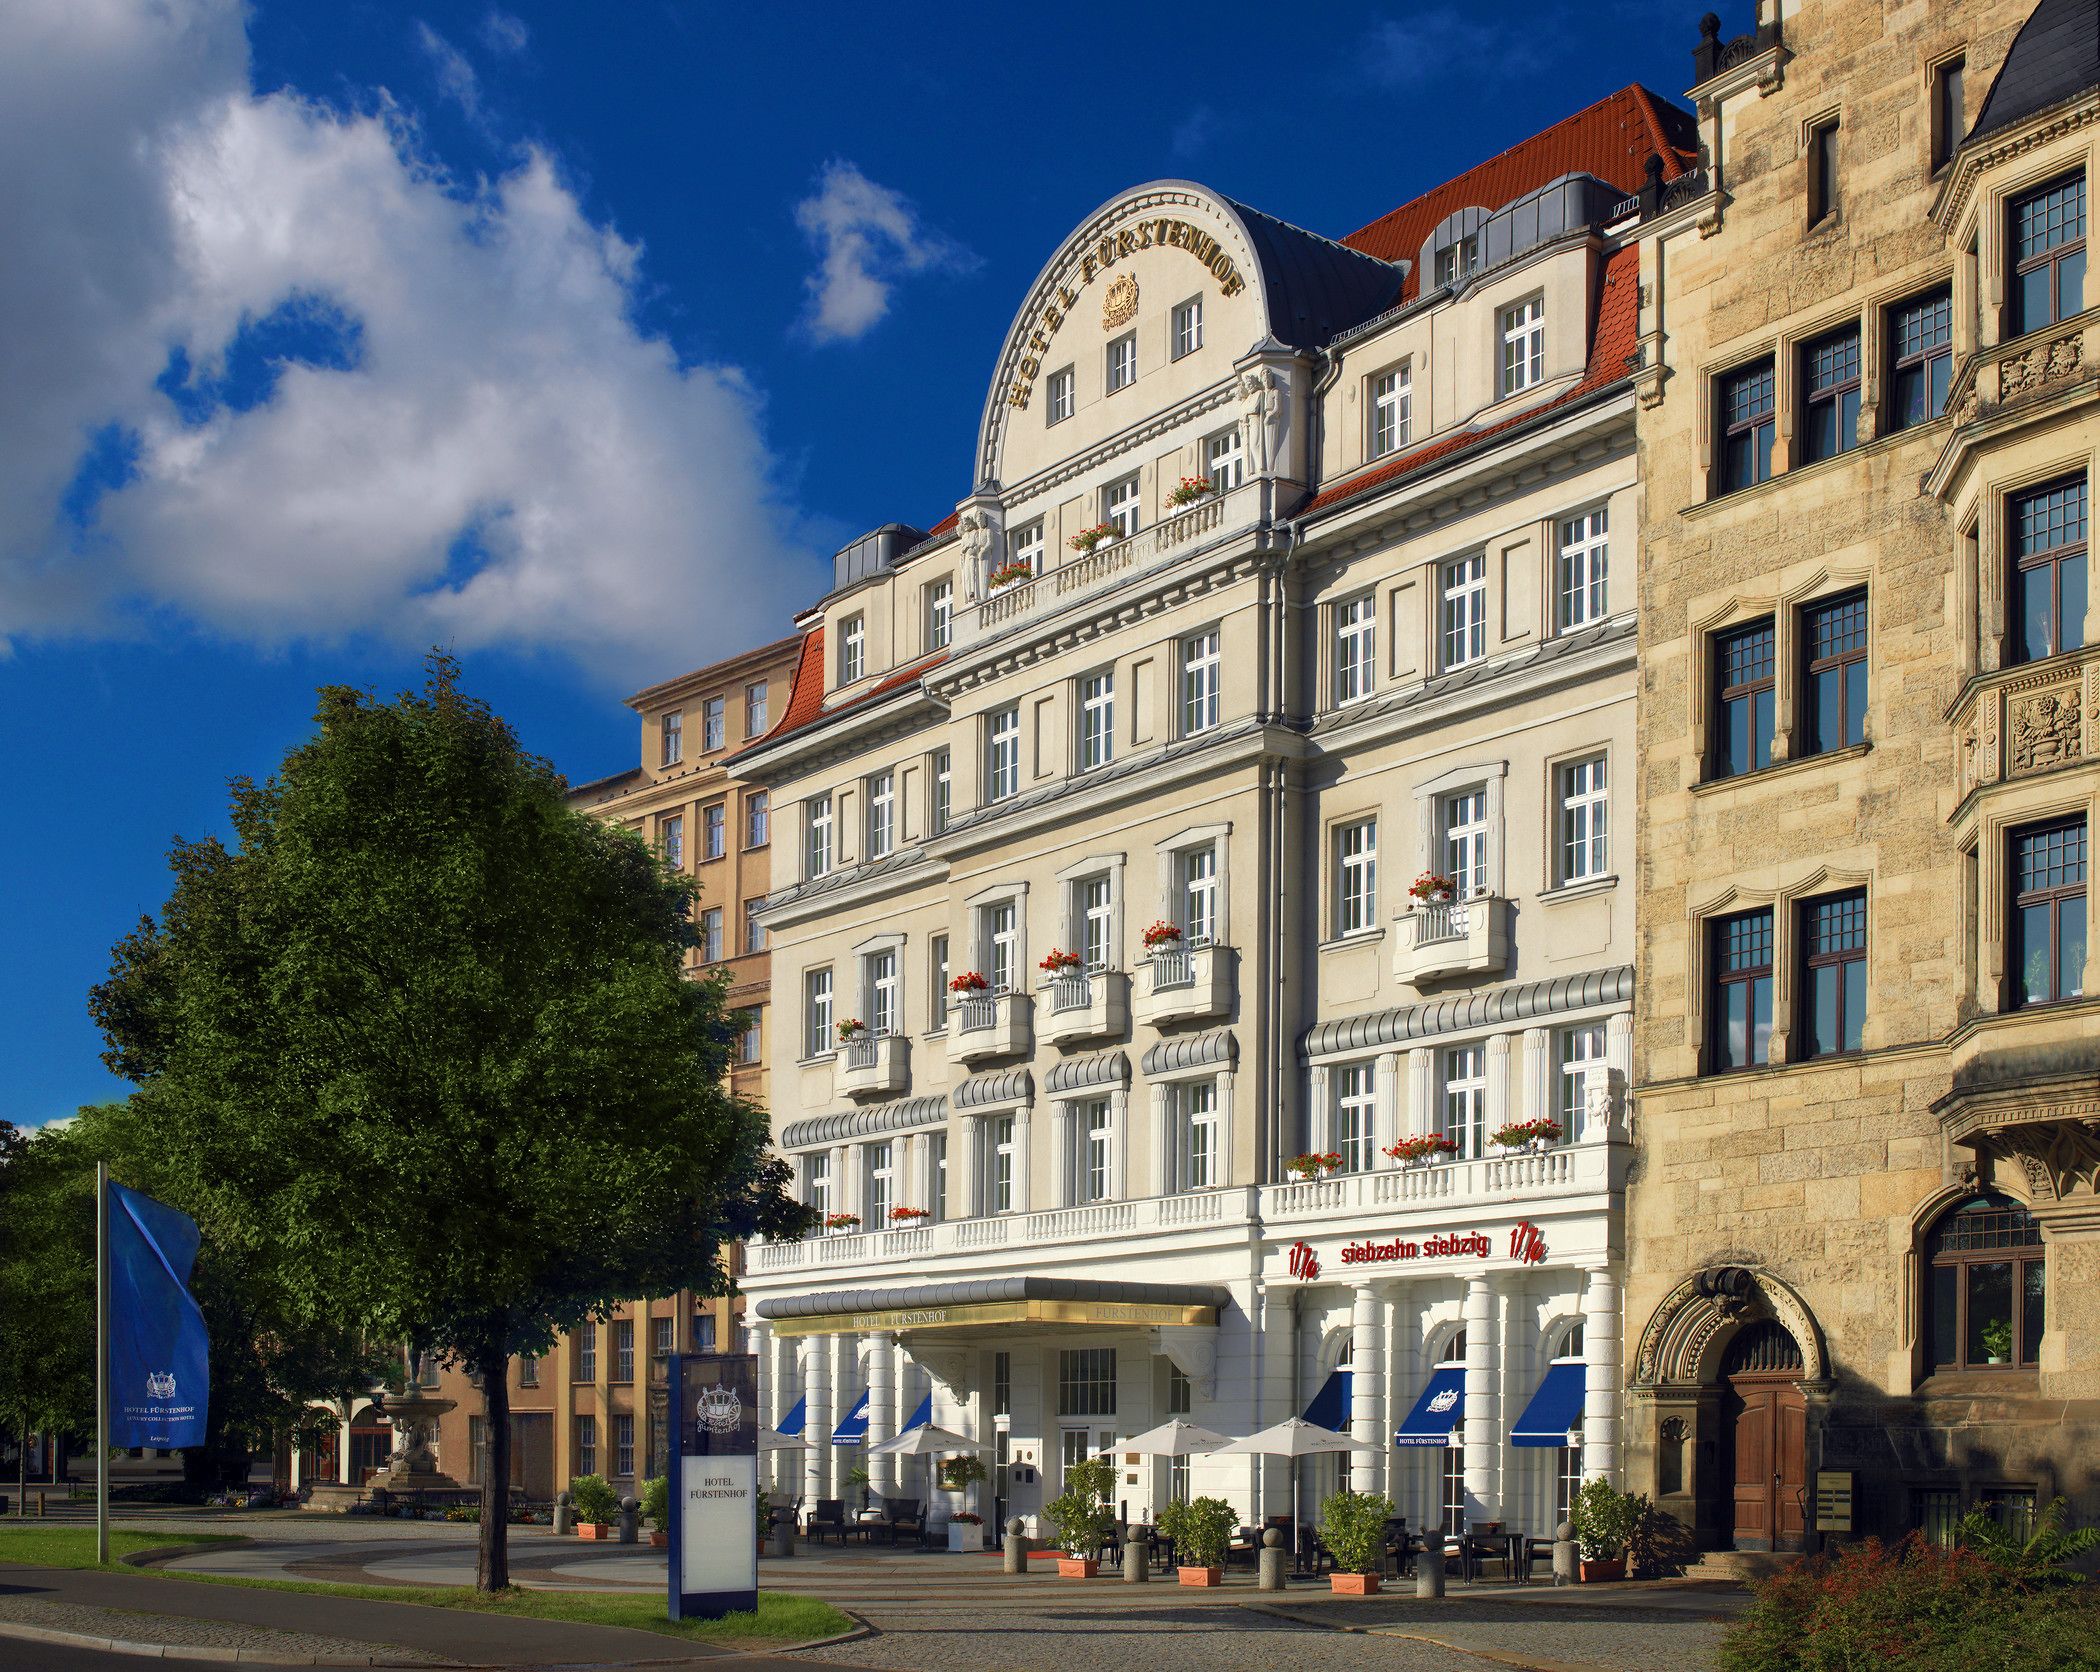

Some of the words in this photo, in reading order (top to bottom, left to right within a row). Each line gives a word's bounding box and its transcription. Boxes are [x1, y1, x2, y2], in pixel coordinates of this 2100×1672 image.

[1009, 287, 1075, 408] HOTEL
[1081, 218, 1243, 297] FÜRSTENHOF
[1341, 1238, 1417, 1263] siebzehn
[1423, 1231, 1488, 1258] siebzig
[853, 1315, 880, 1328] HOTEL
[704, 1478, 734, 1487] HOTEL
[690, 1489, 747, 1499] FÜRSTENHOF
